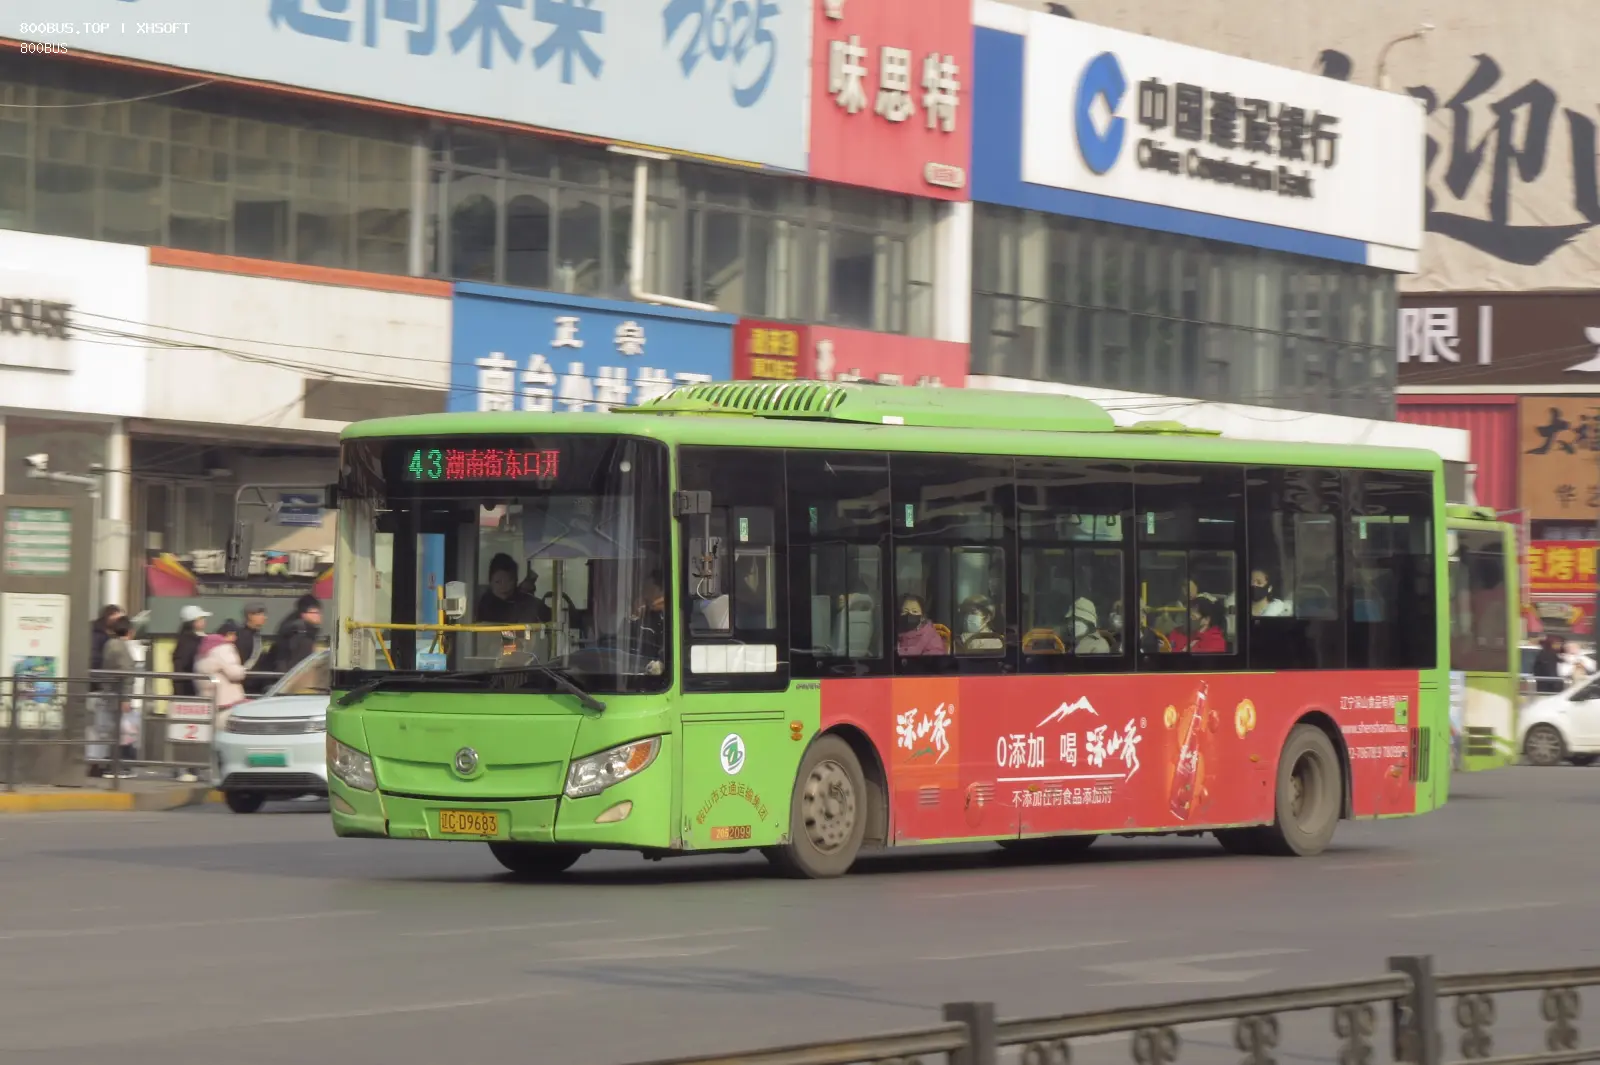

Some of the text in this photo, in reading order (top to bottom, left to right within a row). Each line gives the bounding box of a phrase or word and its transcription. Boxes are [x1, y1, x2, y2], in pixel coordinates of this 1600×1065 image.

[662, 0, 781, 108] 2025
[829, 35, 960, 132] 味思特
[1137, 77, 1340, 169] 中国建设银行
[1404, 53, 1600, 266] 迎
[1397, 307, 1461, 363] 限
[409, 449, 561, 479] 43 湖南街东口开
[996, 733, 1045, 768] 0添加
[1060, 732, 1077, 767] 喝
[1012, 786, 1113, 808] 不添加任何食品添加剂
[729, 827, 751, 839] 2099
